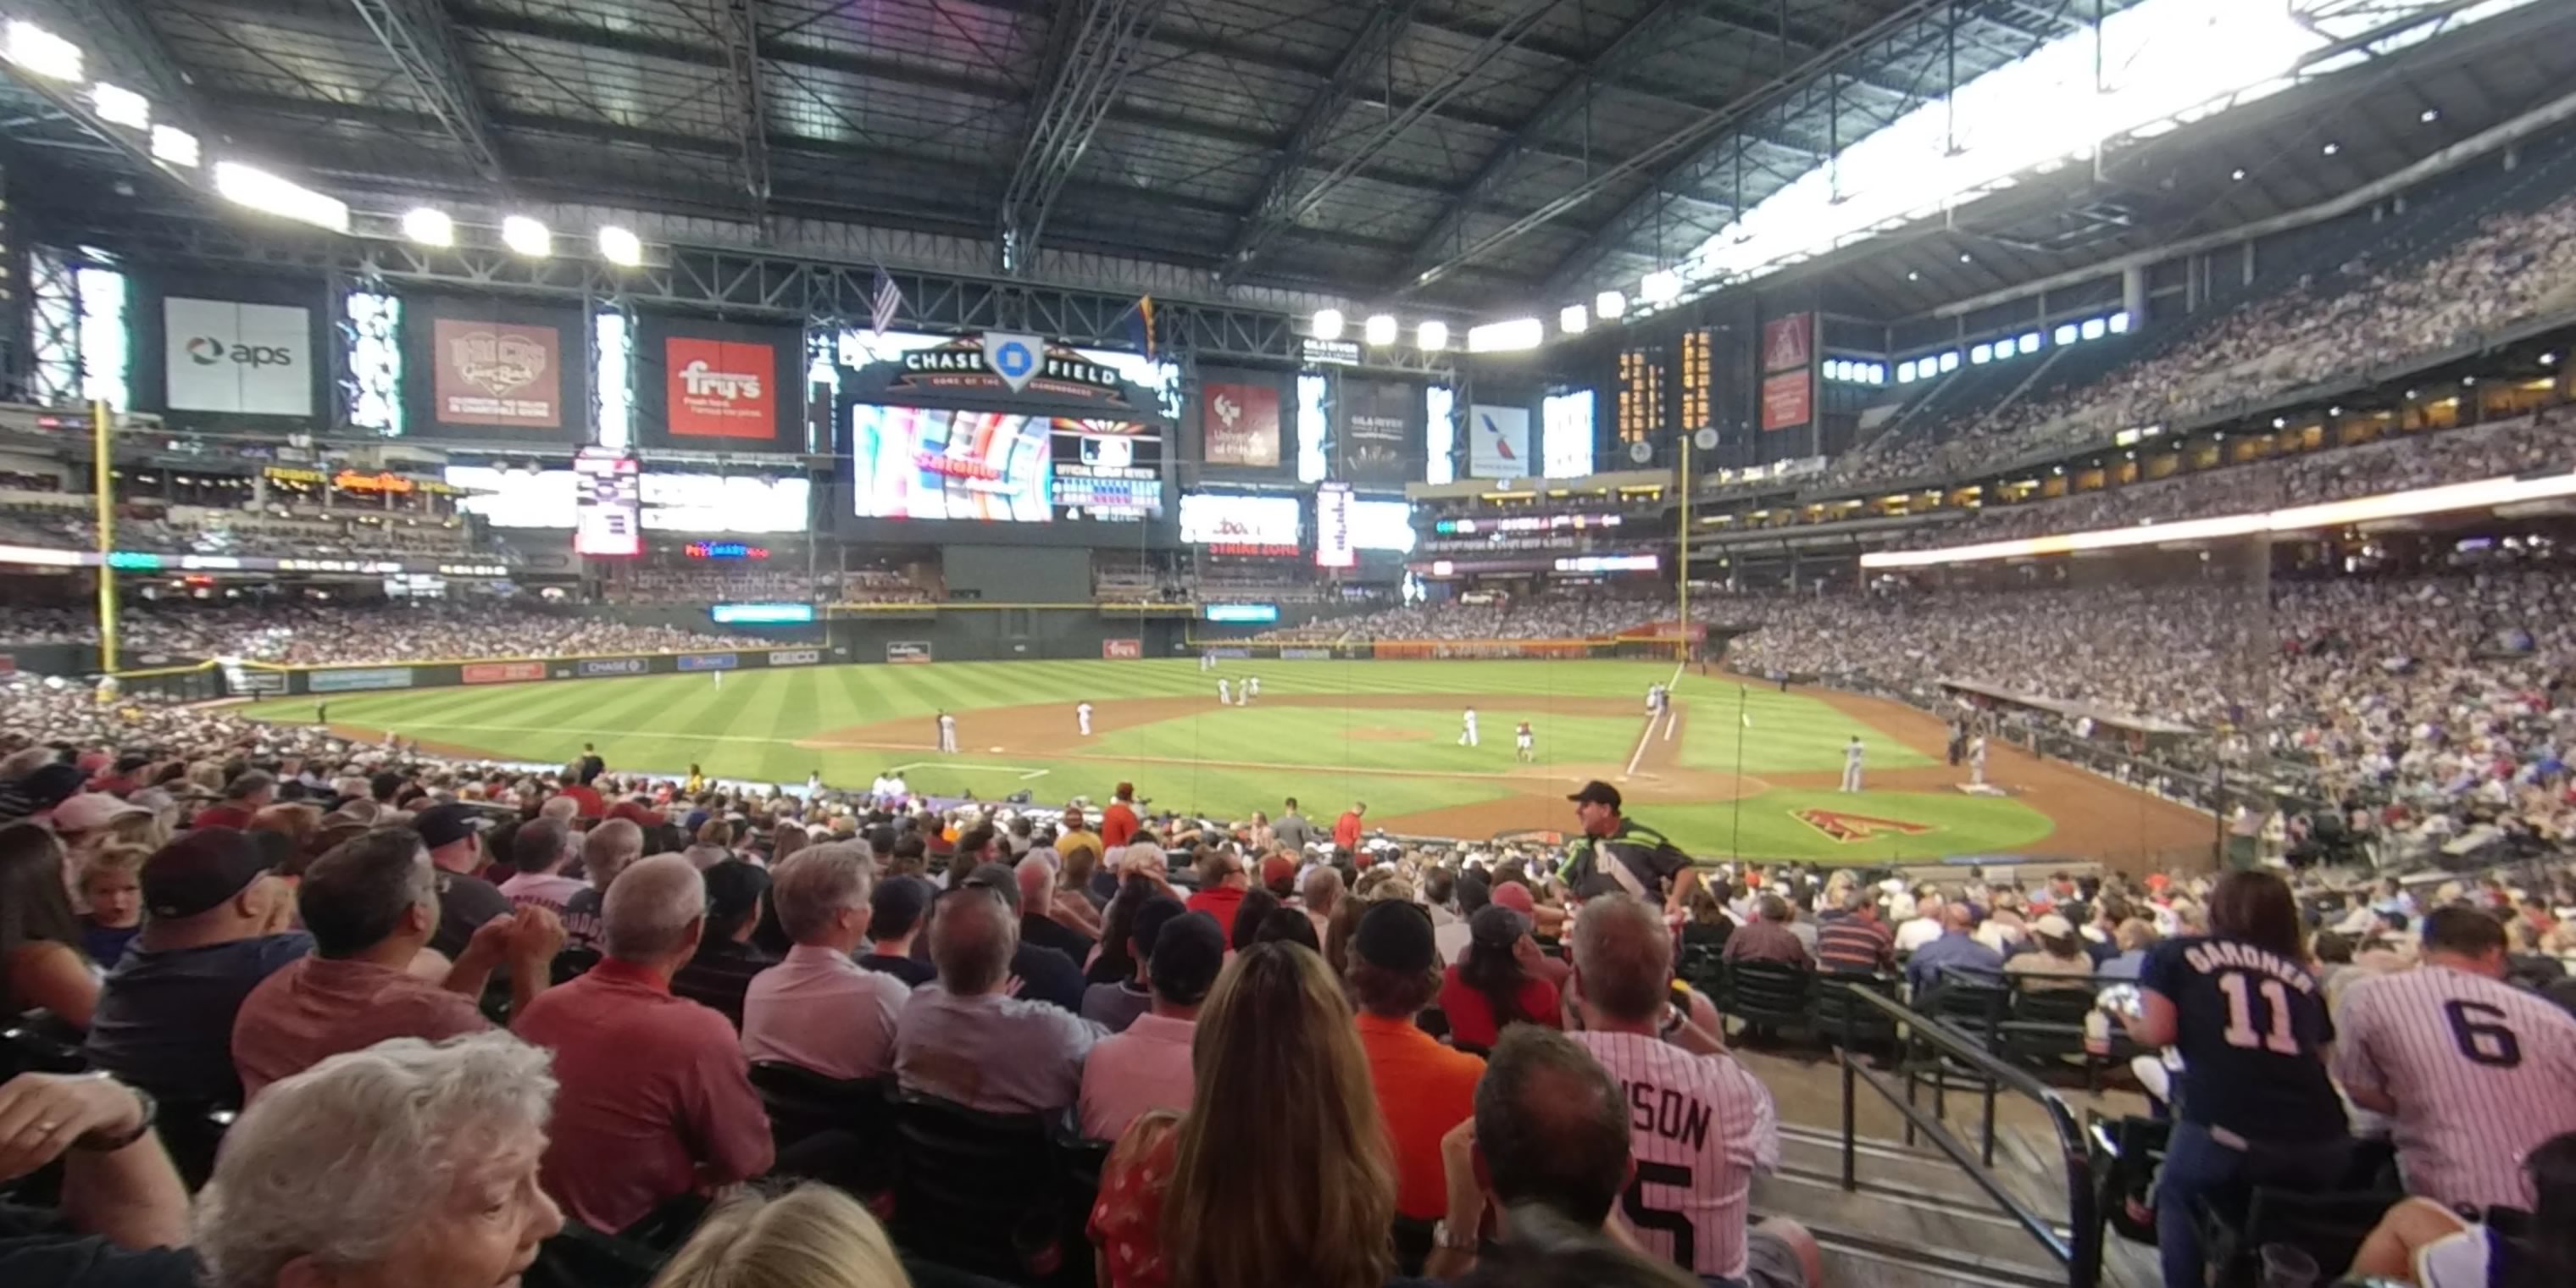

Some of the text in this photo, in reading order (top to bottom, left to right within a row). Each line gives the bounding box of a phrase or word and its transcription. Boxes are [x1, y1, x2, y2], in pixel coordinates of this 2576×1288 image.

[230, 344, 291, 368] aps
[906, 353, 1116, 385] CHASE FIELD
[679, 360, 761, 399] fry's
[588, 661, 627, 673] CHASE
[771, 652, 817, 664] GEICO
[2184, 941, 2314, 996] GARDNER
[2218, 972, 2301, 1056] 11
[2445, 1000, 2522, 1069] 6
[1622, 1079, 1713, 1154] SON
